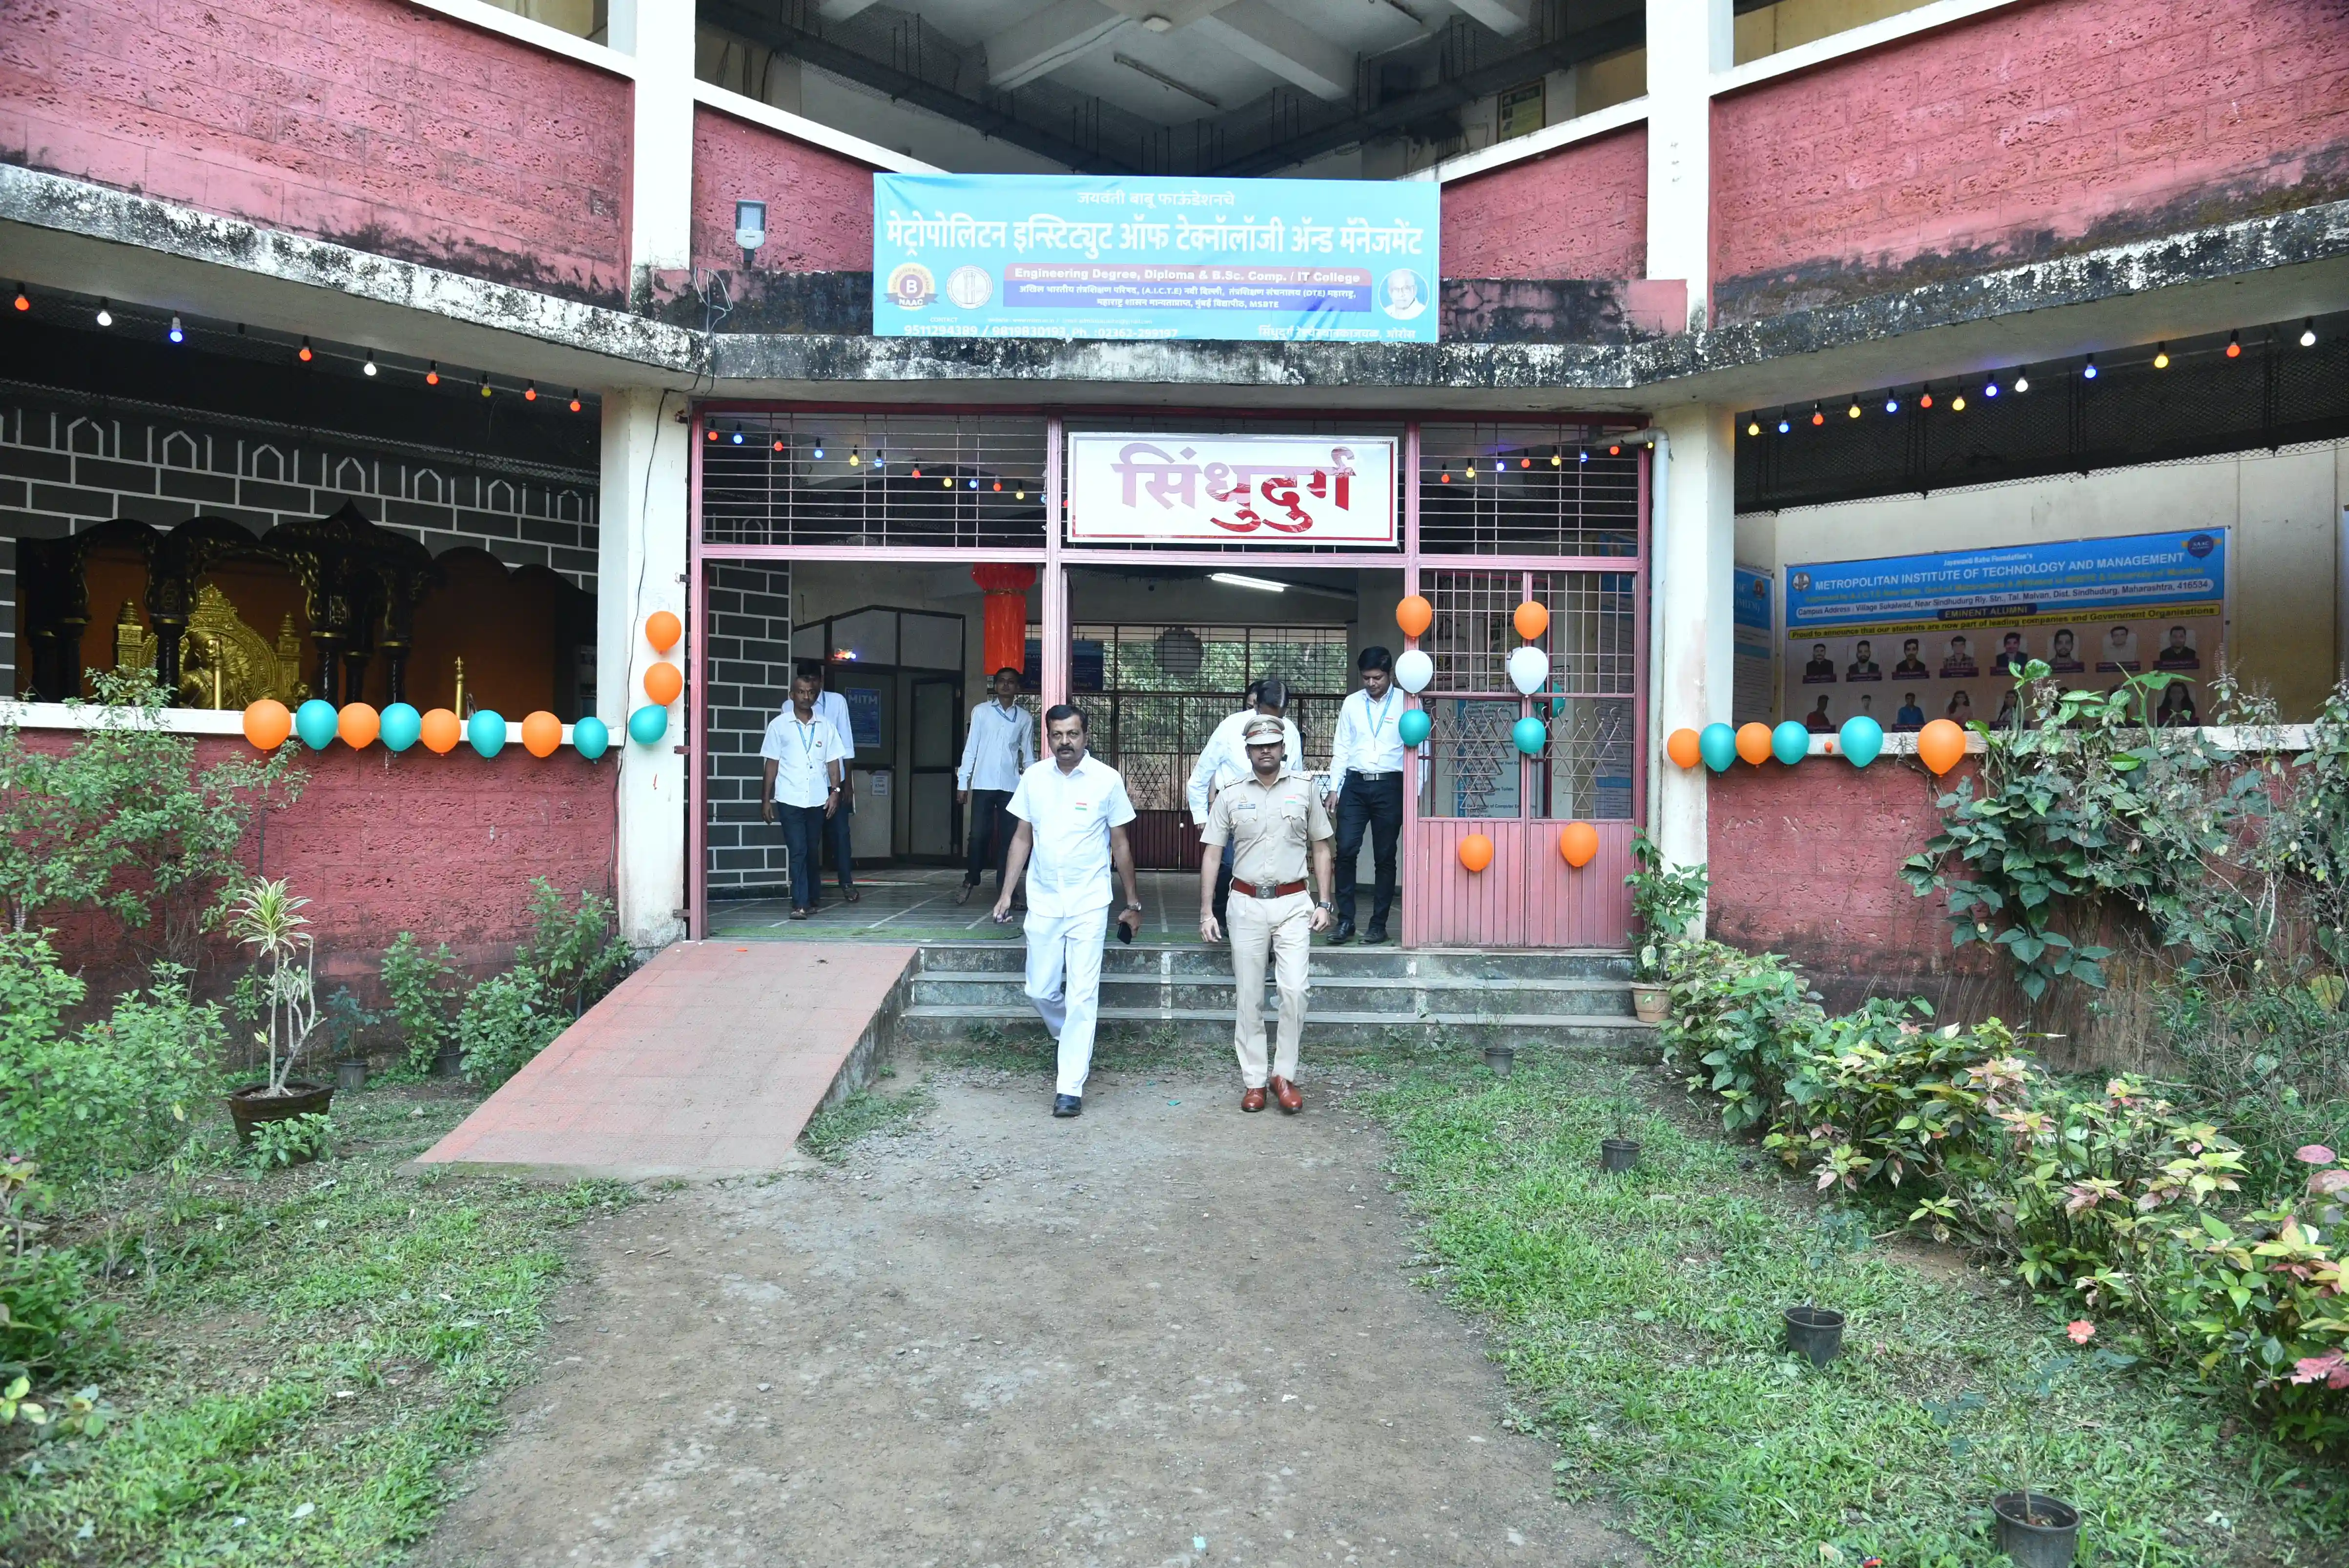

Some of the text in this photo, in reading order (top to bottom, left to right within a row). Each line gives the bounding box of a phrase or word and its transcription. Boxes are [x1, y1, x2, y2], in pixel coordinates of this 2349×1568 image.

[1129, 192, 1156, 209] बाबू
[886, 210, 1007, 256] मेट्रोपोलिटन
[1119, 213, 1170, 250] ऑफ
[1175, 213, 1285, 252] टेक्नॉलॉजी
[1015, 268, 1360, 284] Engineering Degree, Diploma & B.Sc. Comp. / IT College
[907, 280, 917, 293] B
[1019, 284, 1045, 293] अखिल
[1047, 284, 1074, 293] भारतीय
[1141, 287, 1182, 295] (A.I.C.T.E)
[1303, 289, 1326, 298] (DTE)
[1195, 300, 1211, 309] मुंबई
[904, 325, 978, 336] 9511294389
[1072, 328, 1090, 337] Ph.
[1110, 443, 1357, 533] सिंधुदुर्ग
[1815, 552, 2185, 590] METROPOLITAN INSTITUTE OF TECHNOLOGY AND MANAGEMENT
[1798, 608, 1823, 616] Campus
[1824, 605, 1851, 614] Address
[1856, 603, 1878, 612] Village
[1933, 596, 1973, 606] Sindhudurg
[2023, 591, 2052, 600] Malvan,
[2053, 589, 2070, 598] Dist.
[2122, 583, 2175, 594] Maharashtra,
[1945, 606, 2028, 619] EMINENT ALUMNI
[1793, 630, 1813, 639] Proud
[1823, 628, 1859, 637] announce
[1892, 624, 1925, 633] students
[1960, 621, 1977, 631] part
[1989, 618, 2019, 629] leading
[2021, 615, 2068, 626] companies
[2071, 614, 2088, 622] and
[2091, 610, 2145, 620] Government
[2148, 607, 2214, 619] Organisations
[848, 694, 878, 705] MITM
